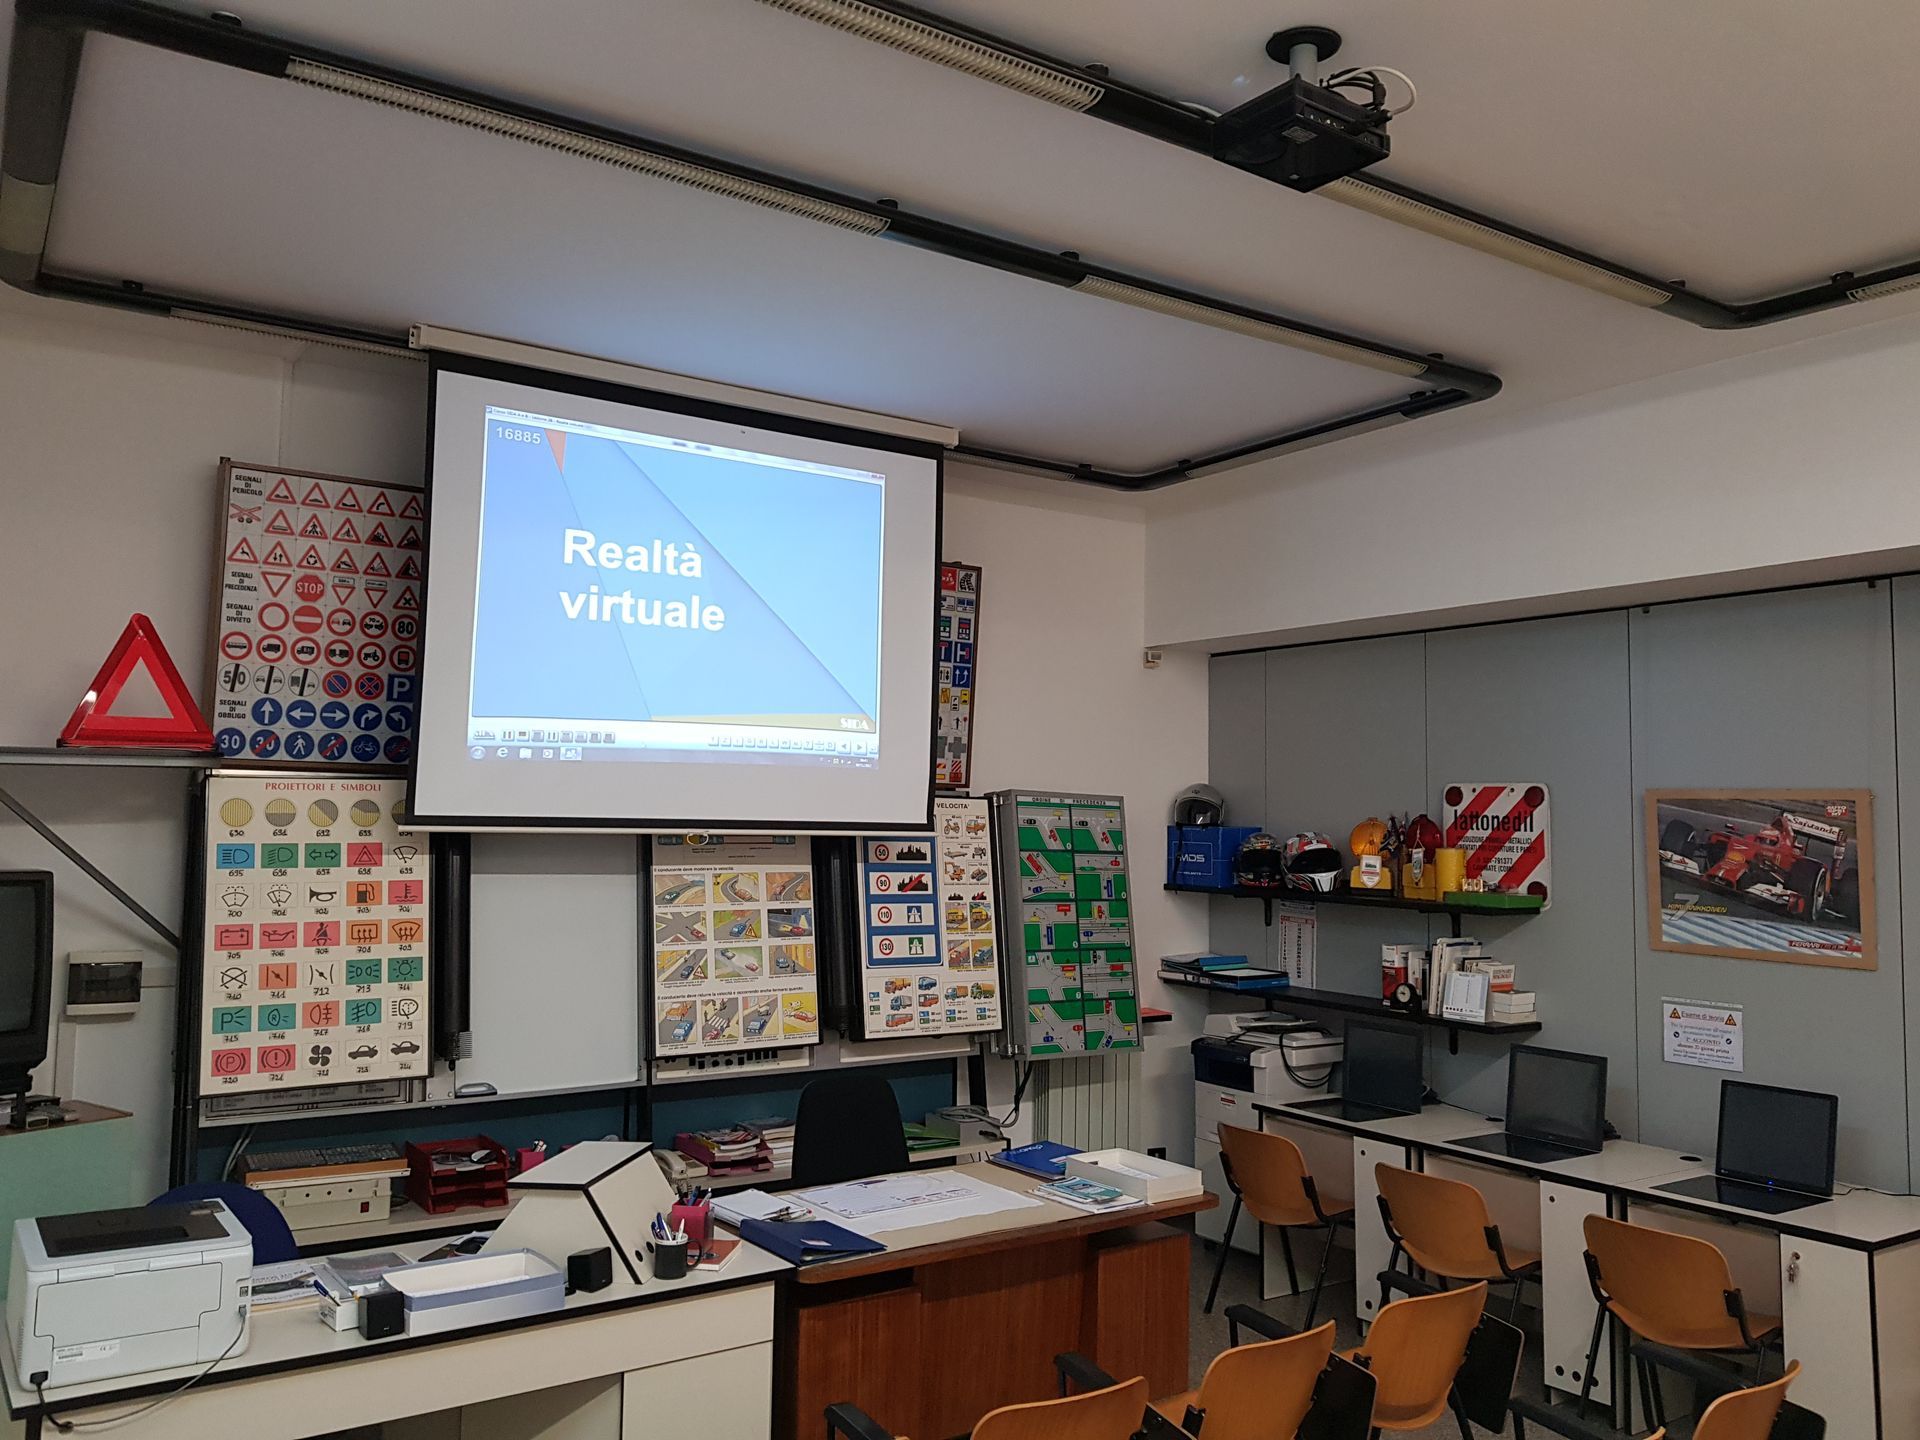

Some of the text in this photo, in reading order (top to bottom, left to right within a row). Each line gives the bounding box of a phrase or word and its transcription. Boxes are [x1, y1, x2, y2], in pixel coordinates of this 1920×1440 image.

[496, 426, 541, 445] 16885
[234, 474, 262, 484] SEGNALI
[232, 487, 263, 496] PERICOLO
[563, 528, 702, 578] Realtà
[231, 571, 253, 579] SEGNALI
[224, 582, 258, 593] PRECEDENZA
[296, 582, 324, 594] STOP
[226, 603, 253, 611] SEGNALI
[559, 585, 726, 632] virtuale
[226, 616, 251, 624] DIVIETO
[397, 621, 414, 635] 80
[394, 678, 409, 699] P
[218, 711, 246, 720] OBBLIGO
[220, 734, 240, 749] 30
[265, 782, 325, 792] PROIETTORI
[341, 783, 382, 792] SIMBOLI
[1454, 809, 1534, 833] lattonedil
[1792, 816, 1838, 836] Santande
[878, 848, 886, 857] 50
[1179, 854, 1205, 862] MDS
[879, 879, 888, 887] 90
[880, 910, 890, 919] 110
[881, 942, 892, 951] 130
[313, 987, 330, 996] 712
